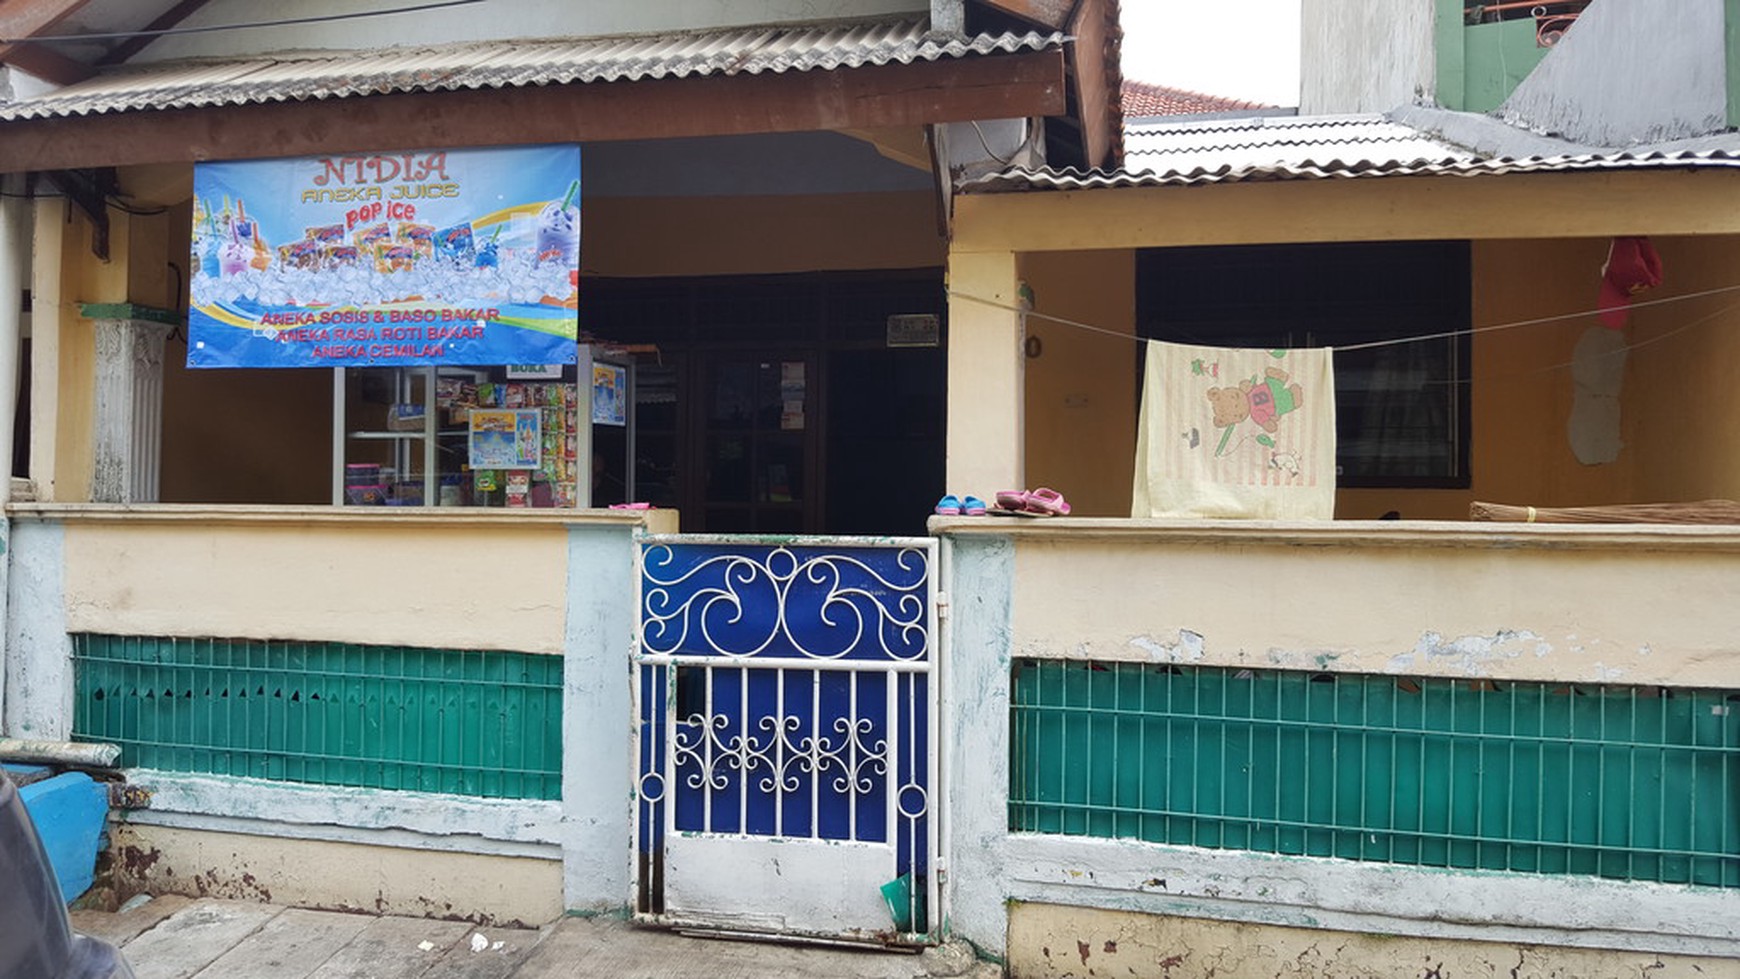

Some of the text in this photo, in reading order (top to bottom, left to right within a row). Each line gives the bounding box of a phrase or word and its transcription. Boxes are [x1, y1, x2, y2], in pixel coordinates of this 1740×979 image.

[314, 151, 449, 185] NIDIA
[302, 183, 460, 203] ANEKA JUICE
[261, 308, 500, 325] ANEKA SOSIS & BASO BAKAR
[275, 325, 484, 342] ANEKA RASA ROTI BAKAR
[312, 343, 444, 358] ANEKA CEMILAN
